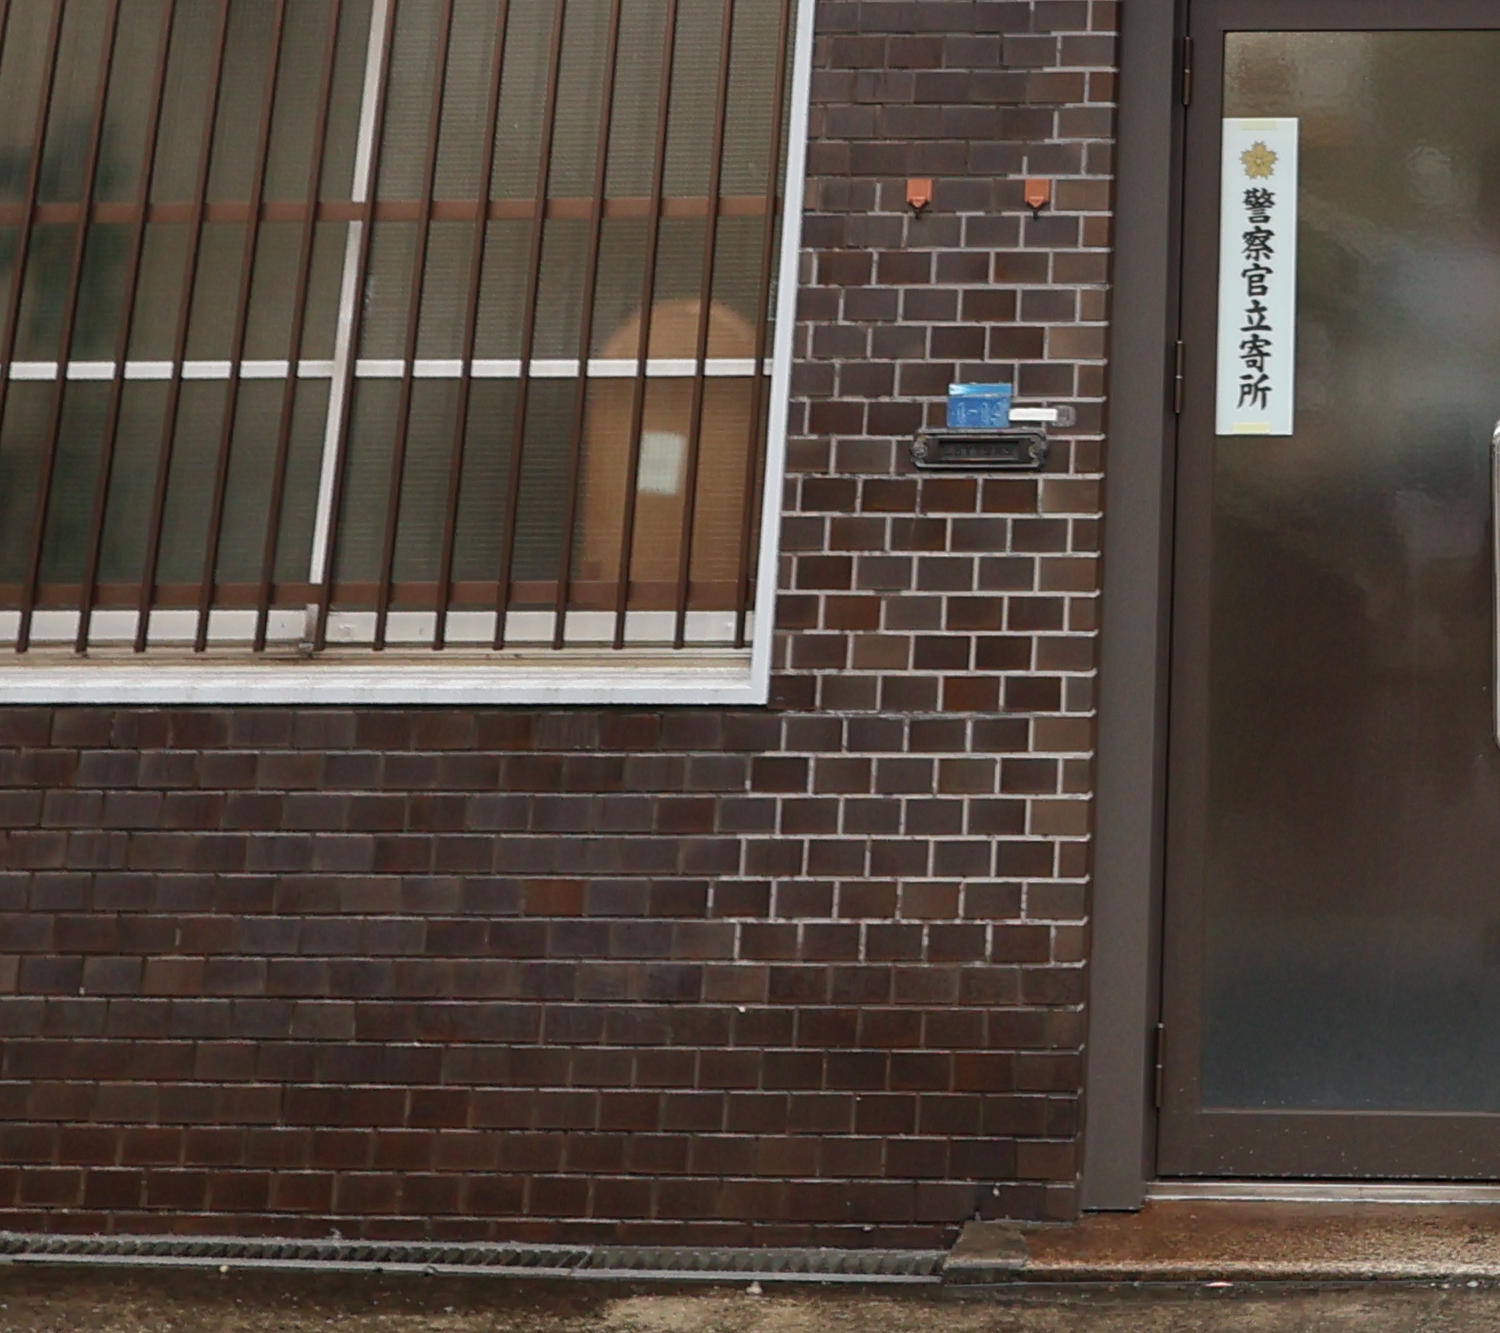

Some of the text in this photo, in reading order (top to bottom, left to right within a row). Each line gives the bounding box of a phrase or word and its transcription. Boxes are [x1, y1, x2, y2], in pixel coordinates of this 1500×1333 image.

[1236, 187, 1276, 411] 警察官立寄所
